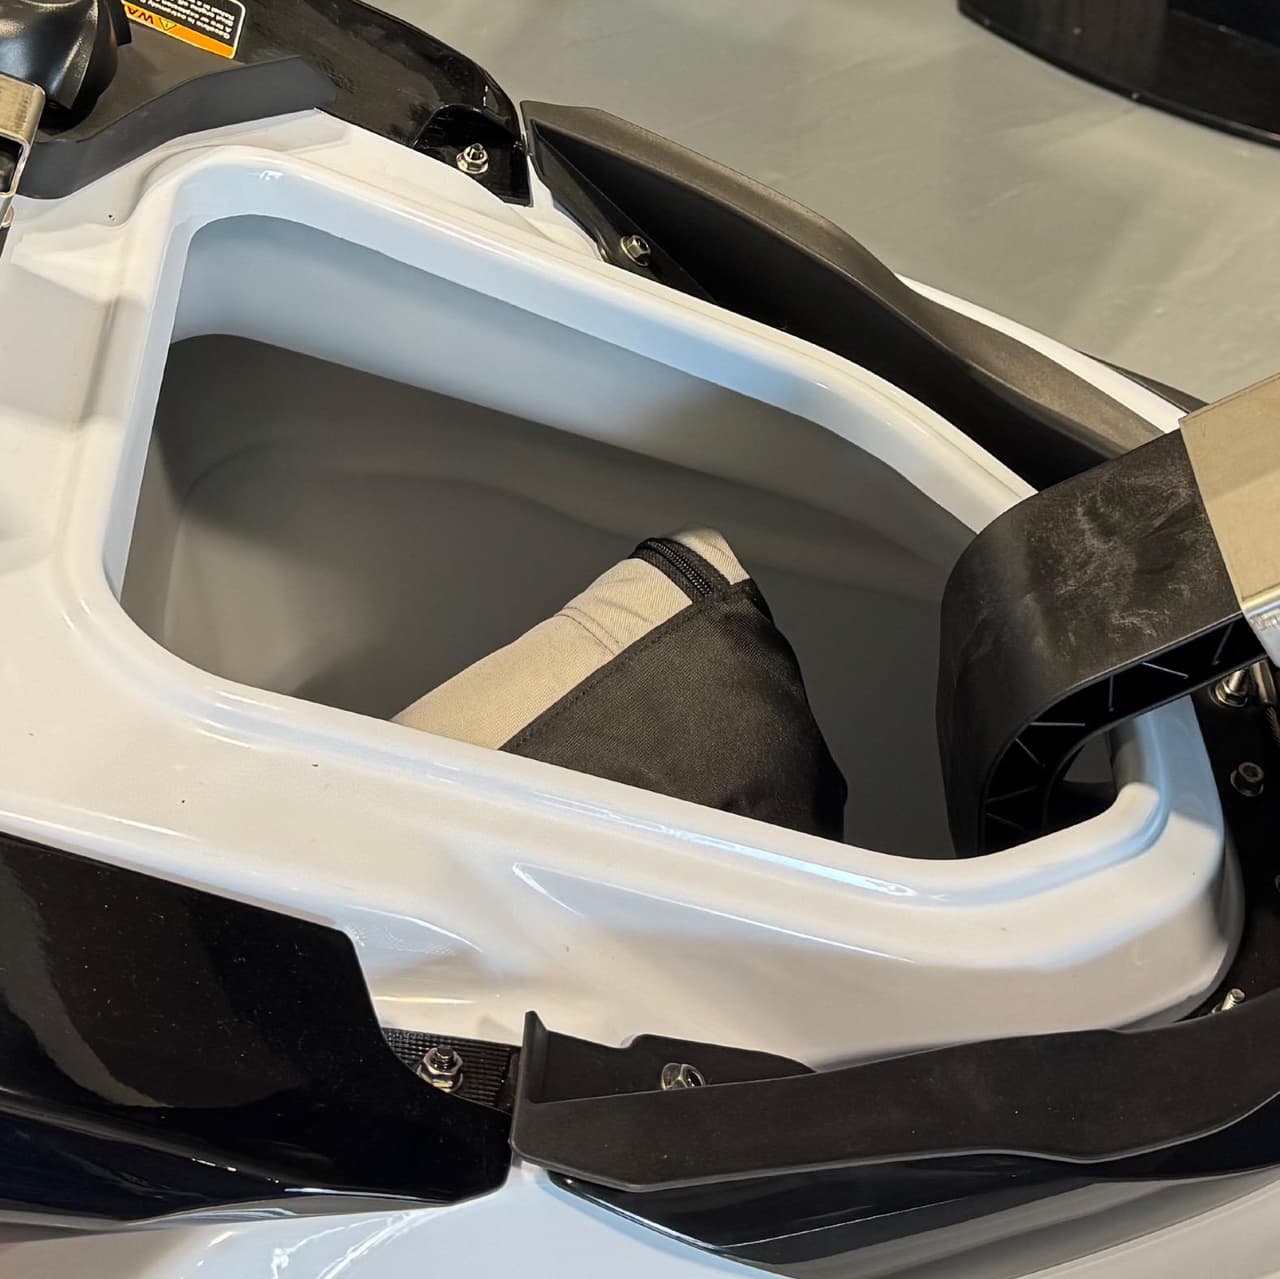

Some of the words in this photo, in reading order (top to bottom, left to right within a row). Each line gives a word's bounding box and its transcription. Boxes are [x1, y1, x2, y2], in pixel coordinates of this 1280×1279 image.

[148, 0, 187, 20] extremely
[161, 0, 200, 19] explosion
[190, 4, 215, 18] engine
[210, 6, 235, 21] Refuel
[196, 20, 230, 39] Gasoline
[210, 20, 224, 29] fire
